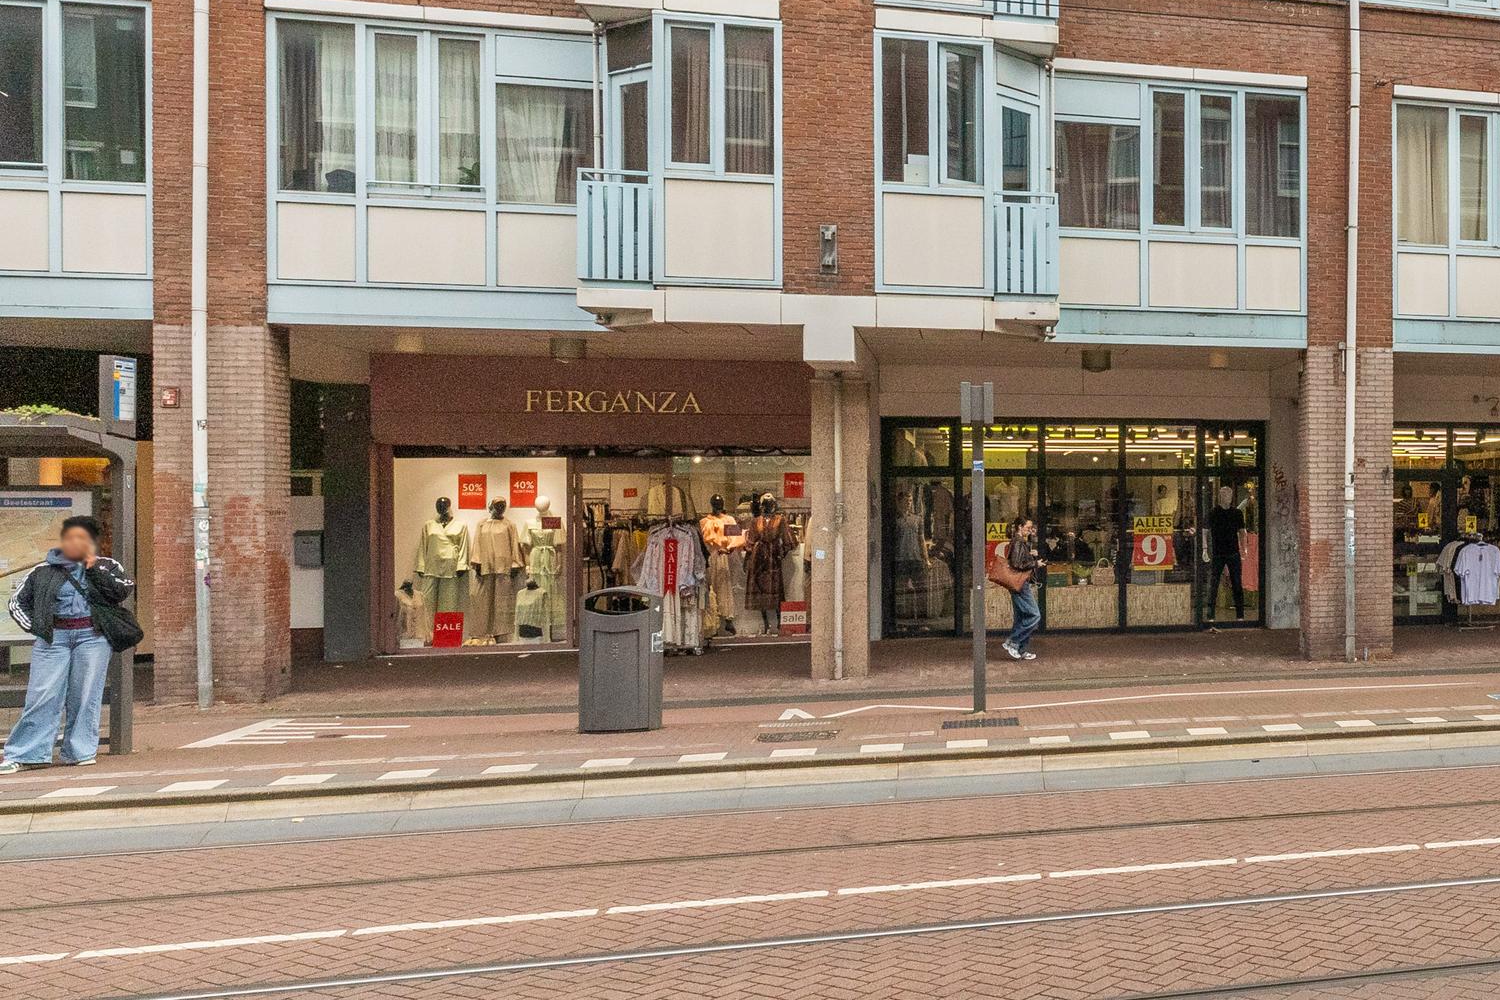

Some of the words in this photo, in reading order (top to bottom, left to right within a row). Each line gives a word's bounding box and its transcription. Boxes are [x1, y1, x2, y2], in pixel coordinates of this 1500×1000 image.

[462, 484, 483, 492] 50%
[513, 481, 534, 489] 40%
[1135, 518, 1172, 527] ALLES
[1142, 534, 1167, 565] 9
[783, 614, 804, 622] sale
